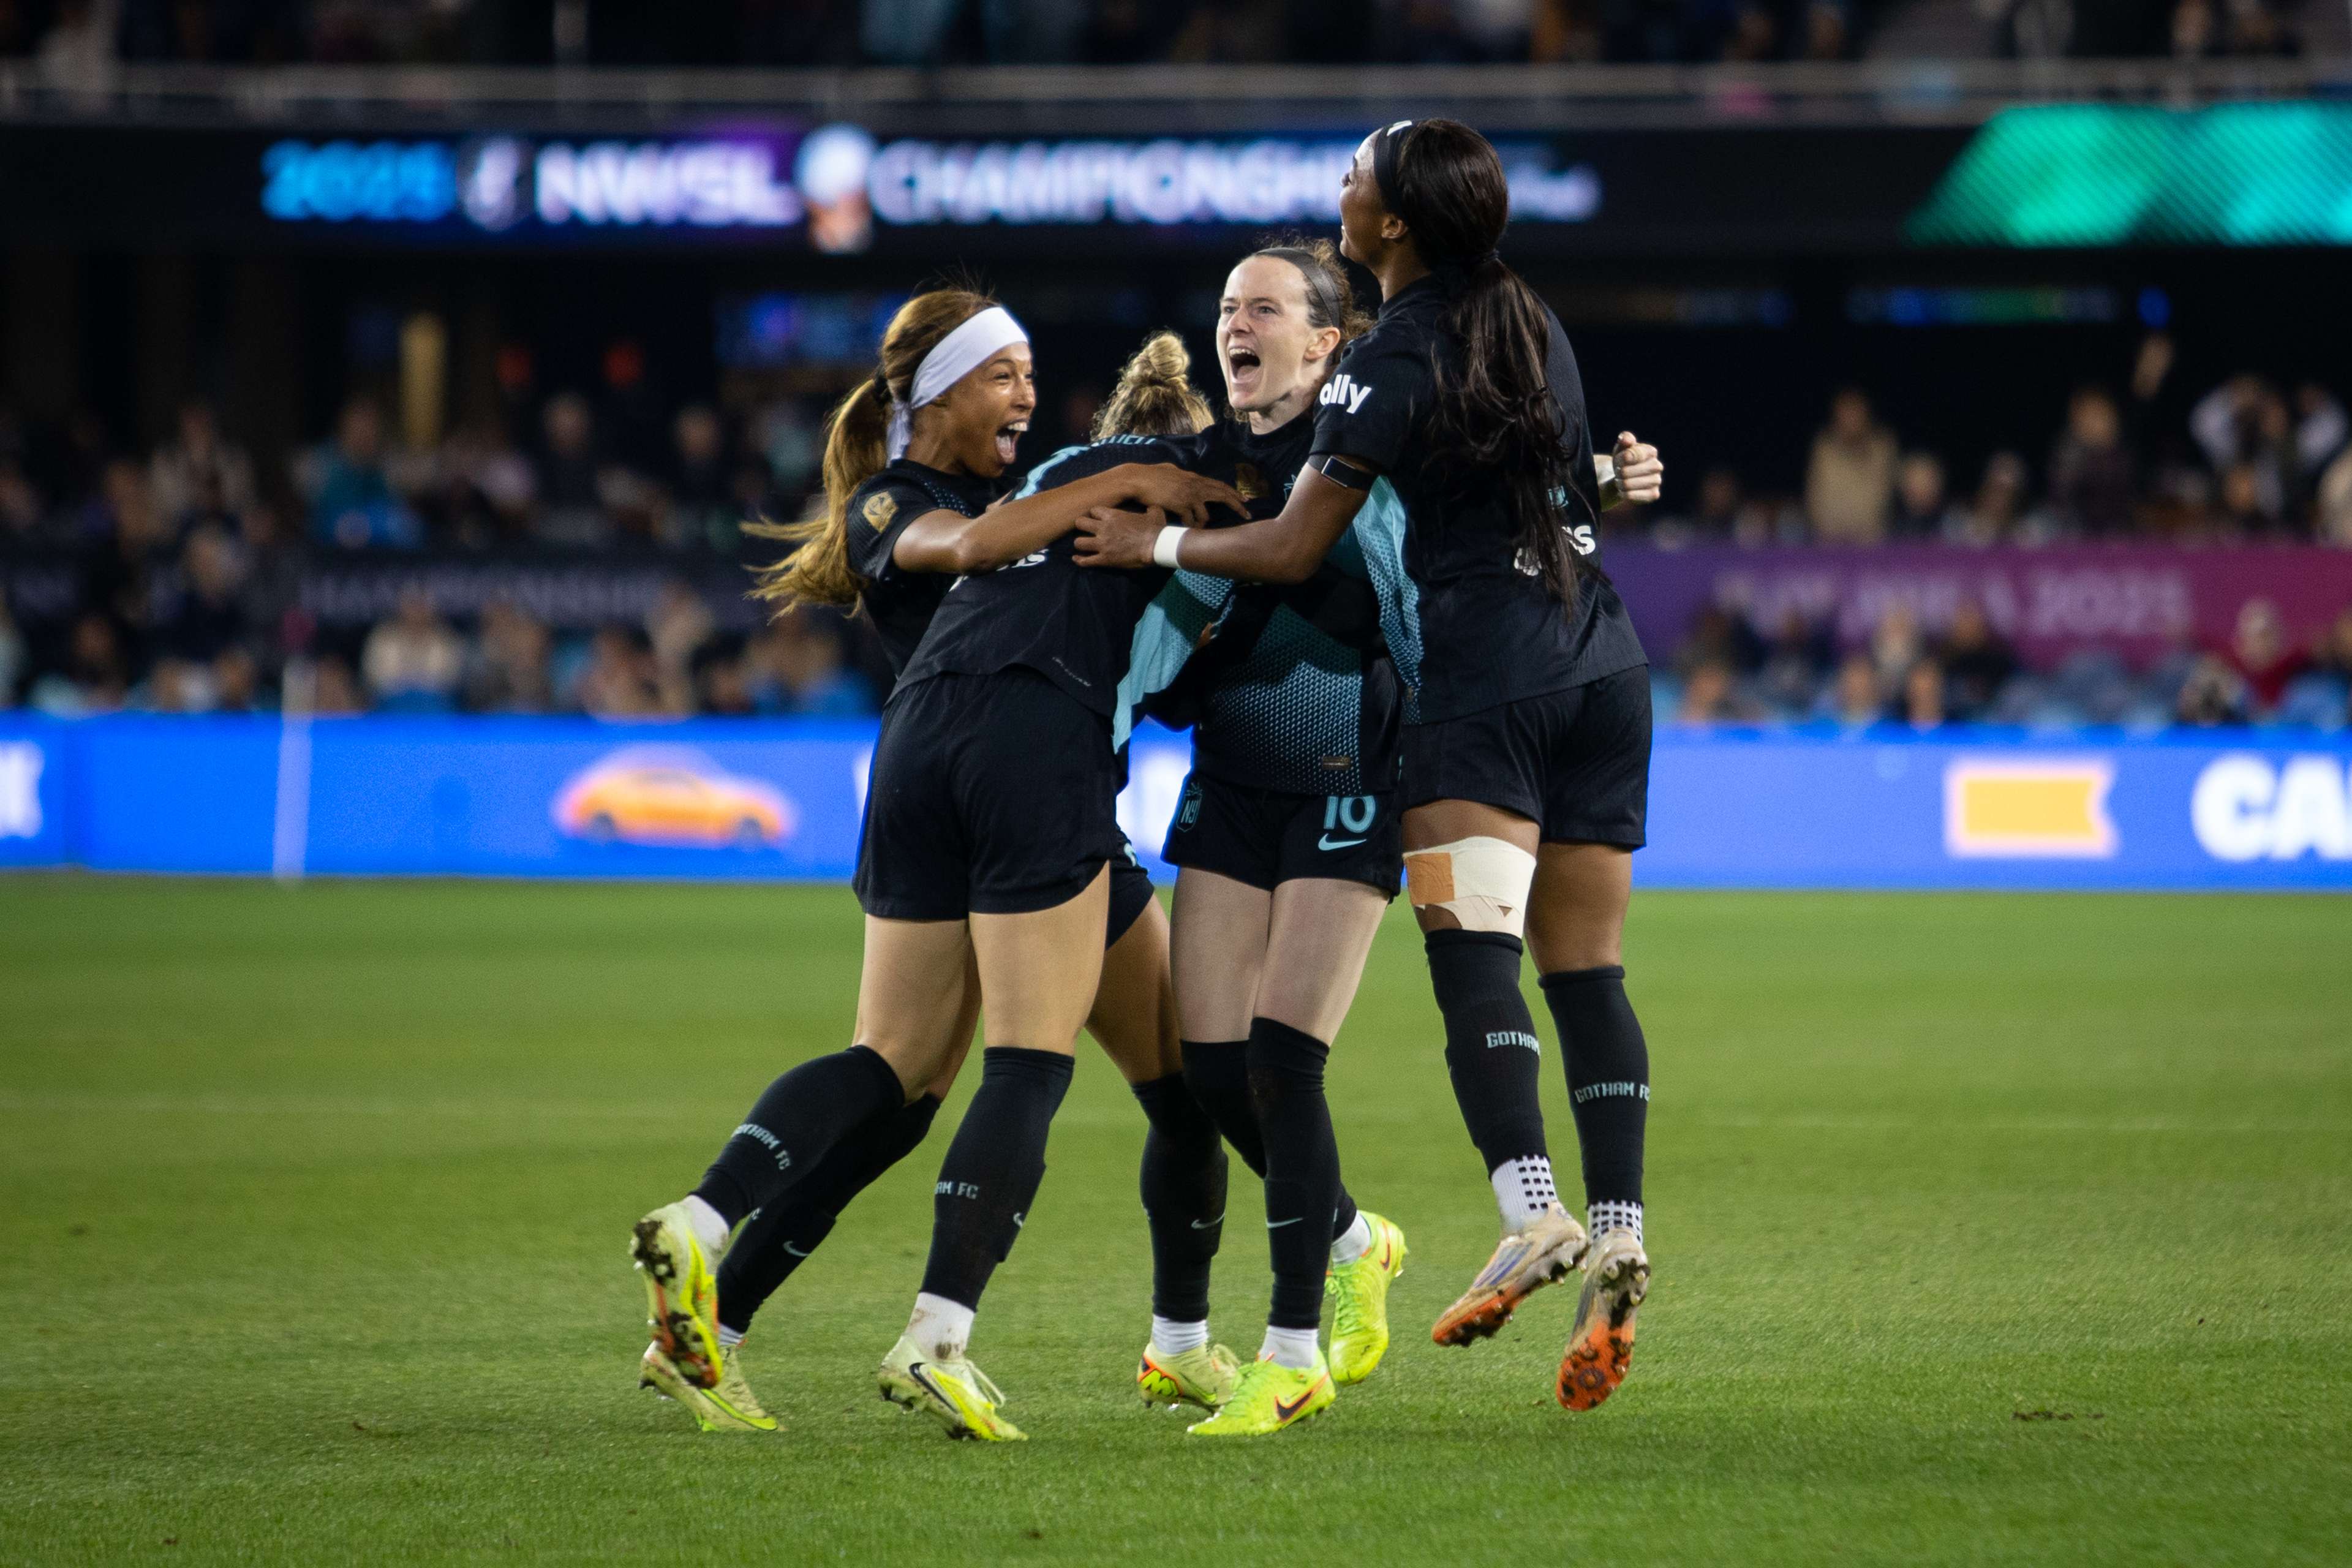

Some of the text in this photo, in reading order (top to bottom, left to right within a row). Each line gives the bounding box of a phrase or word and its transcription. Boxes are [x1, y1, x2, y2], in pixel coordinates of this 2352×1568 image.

[262, 141, 452, 220] 2025
[535, 142, 800, 224] NWSL
[1319, 374, 1372, 415] ally
[1323, 796, 1376, 834] 10
[2191, 753, 2352, 861] CA
[1574, 1081, 1635, 1104] GOTHAM
[775, 1149, 791, 1170] FC
[957, 1181, 979, 1200] FC
